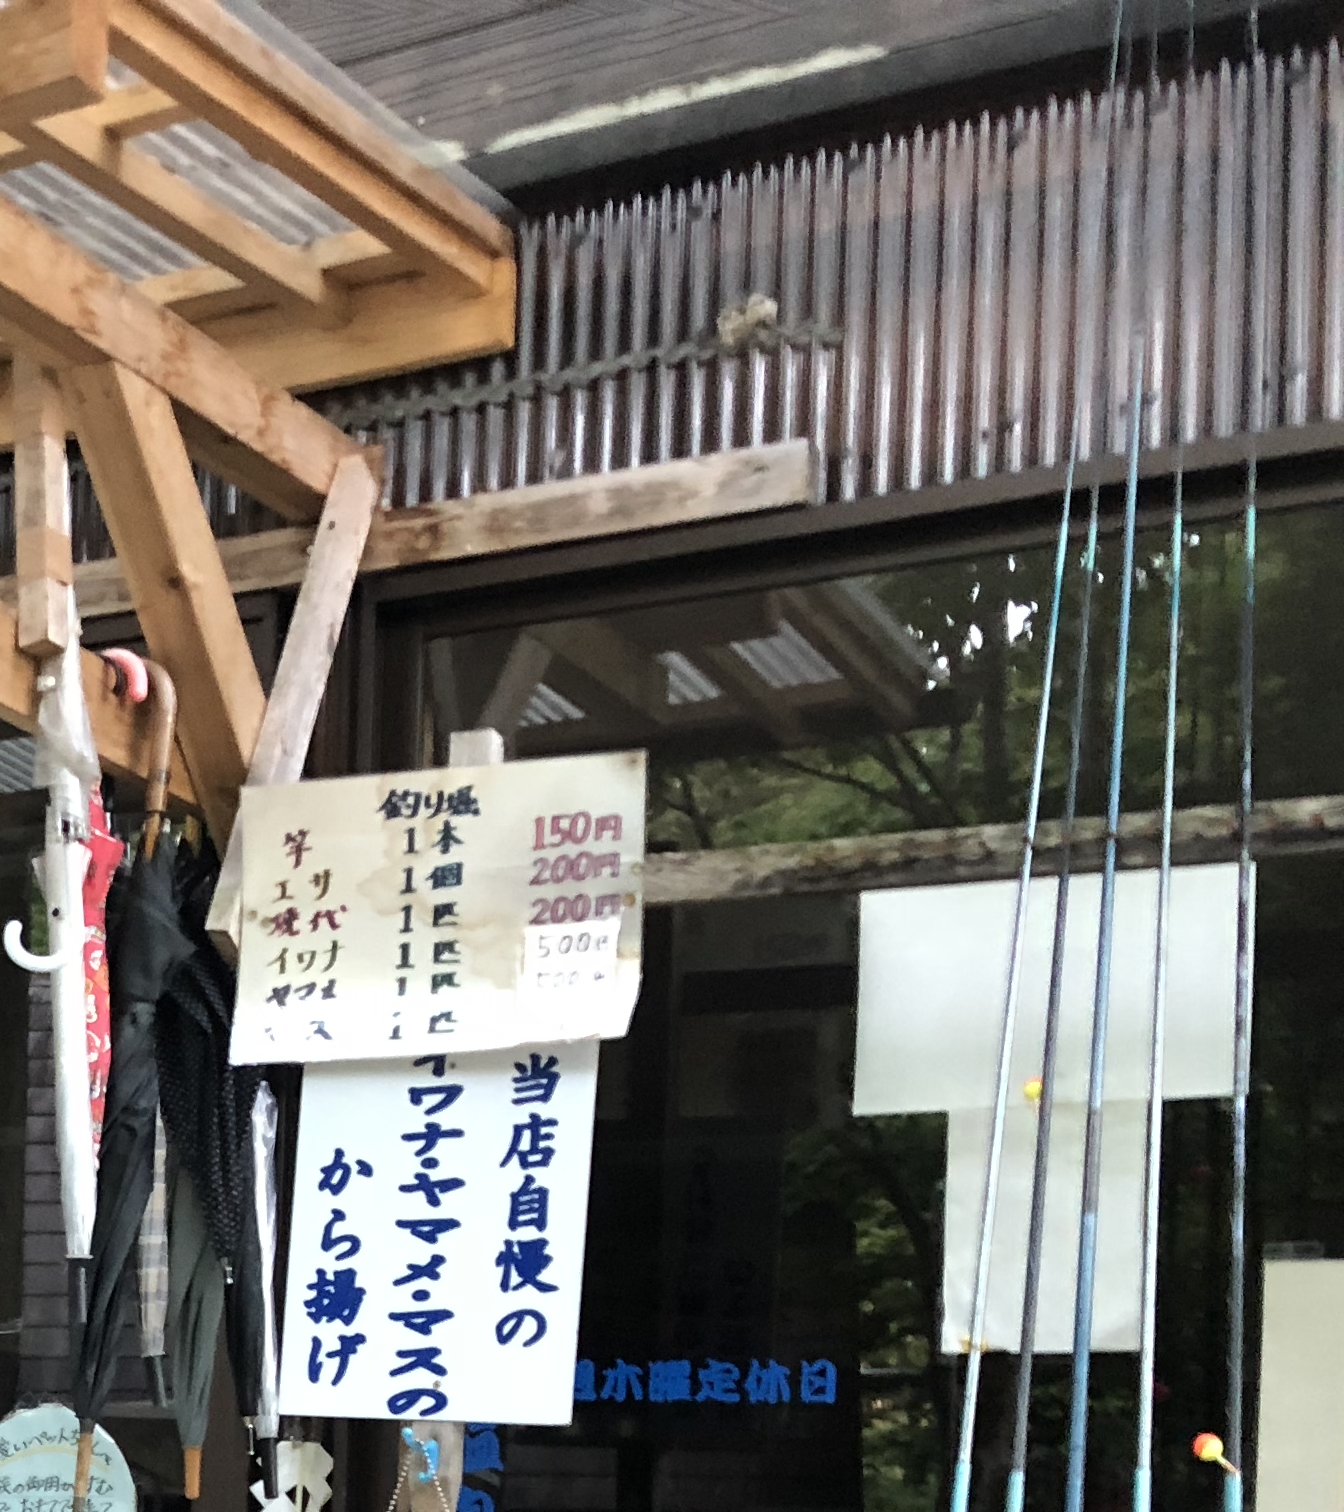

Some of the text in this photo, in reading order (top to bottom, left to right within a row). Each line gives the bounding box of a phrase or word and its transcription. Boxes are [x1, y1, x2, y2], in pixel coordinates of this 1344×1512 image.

[377, 784, 482, 820] 釣り堀
[533, 811, 623, 850] 150円
[529, 851, 621, 887] 200円
[529, 893, 621, 925] 200円
[266, 940, 345, 974] イワナ
[495, 1053, 561, 1348] 当店自慢の
[303, 1148, 374, 1387] から揚げ
